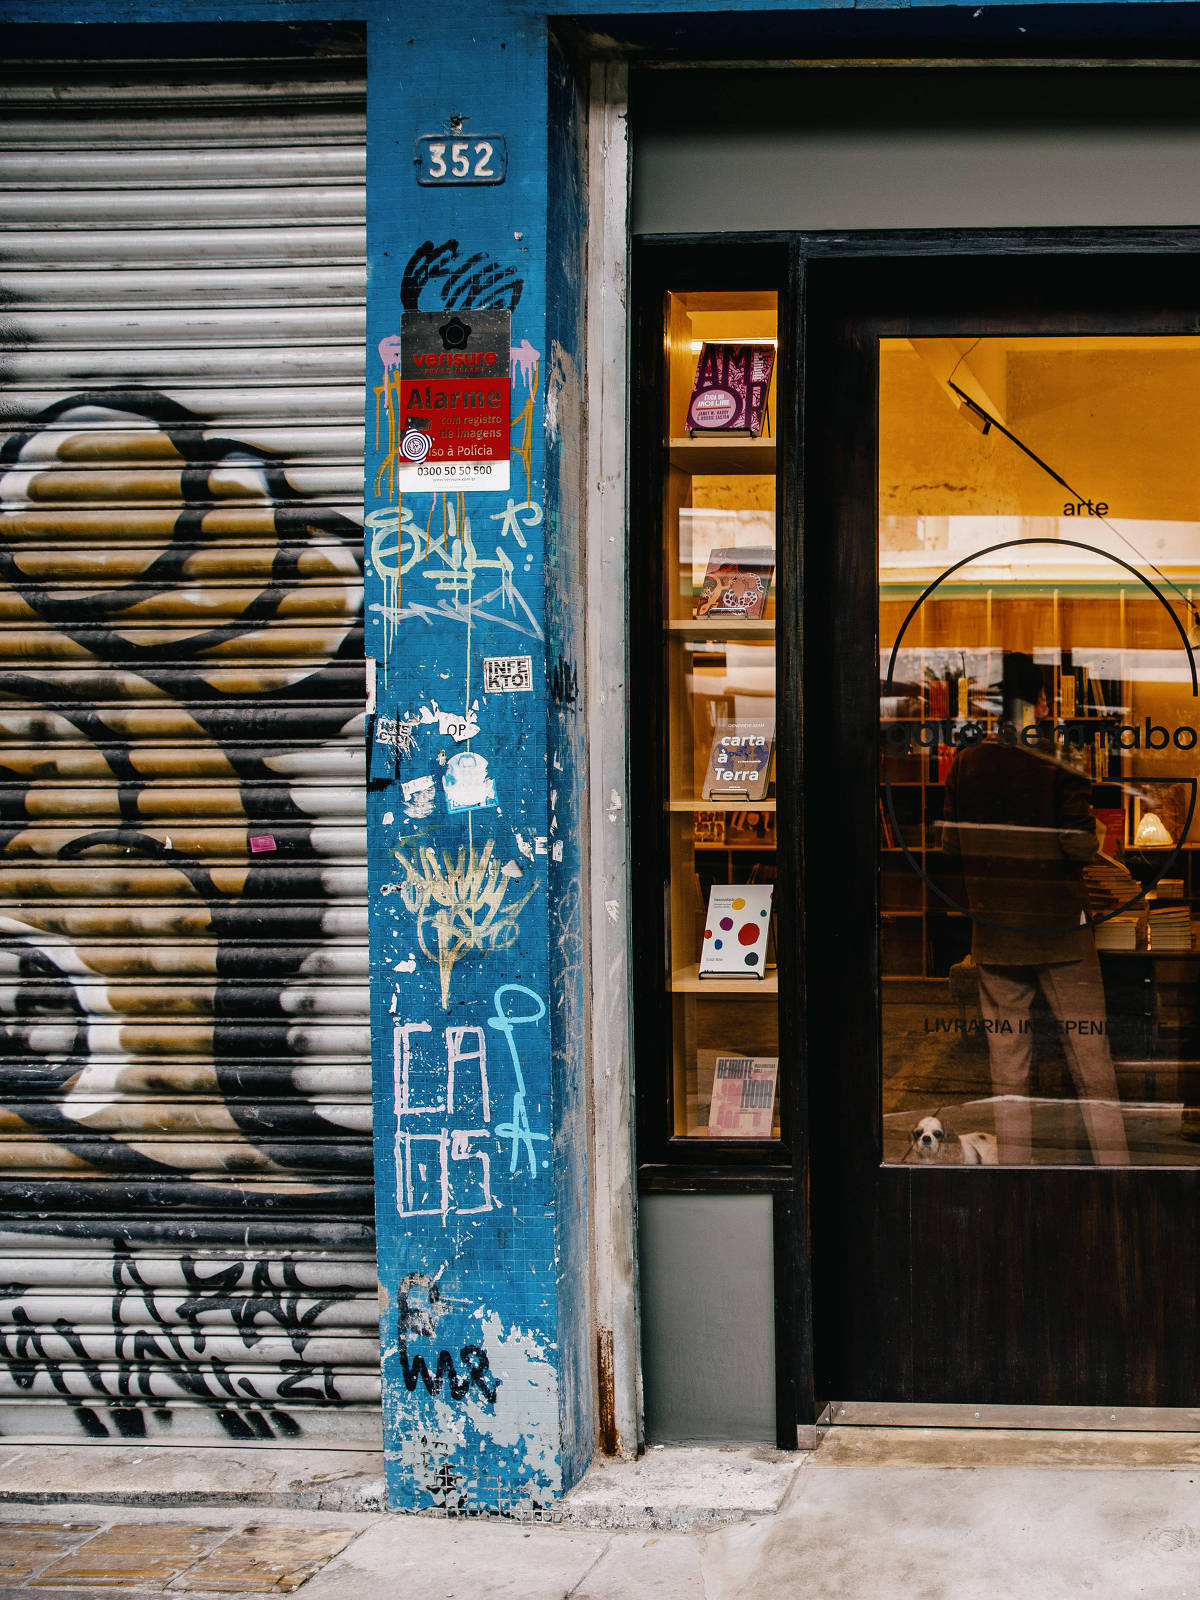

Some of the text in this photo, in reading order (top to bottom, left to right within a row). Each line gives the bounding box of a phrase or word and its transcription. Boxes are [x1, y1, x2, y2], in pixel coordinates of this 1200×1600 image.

[428, 141, 494, 178] 352
[413, 351, 497, 367] verisure
[407, 387, 502, 411] Alarme
[440, 414, 502, 427] com registro
[440, 428, 502, 440] de imagens
[447, 445, 454, 456] à
[457, 444, 493, 456] Polícia
[417, 465, 492, 476] 0300 50 50 500
[1063, 499, 1109, 517] arte
[488, 661, 528, 674] INFE
[488, 674, 529, 688] KTO!
[720, 734, 766, 747] carta
[886, 720, 984, 756] gato
[998, 722, 1085, 749] sem
[717, 748, 729, 764] à
[714, 767, 759, 781] Terra
[924, 1017, 1014, 1035] LIVRARIA
[717, 1059, 754, 1079] BEIRUTE
[740, 1079, 774, 1109] NOIR
